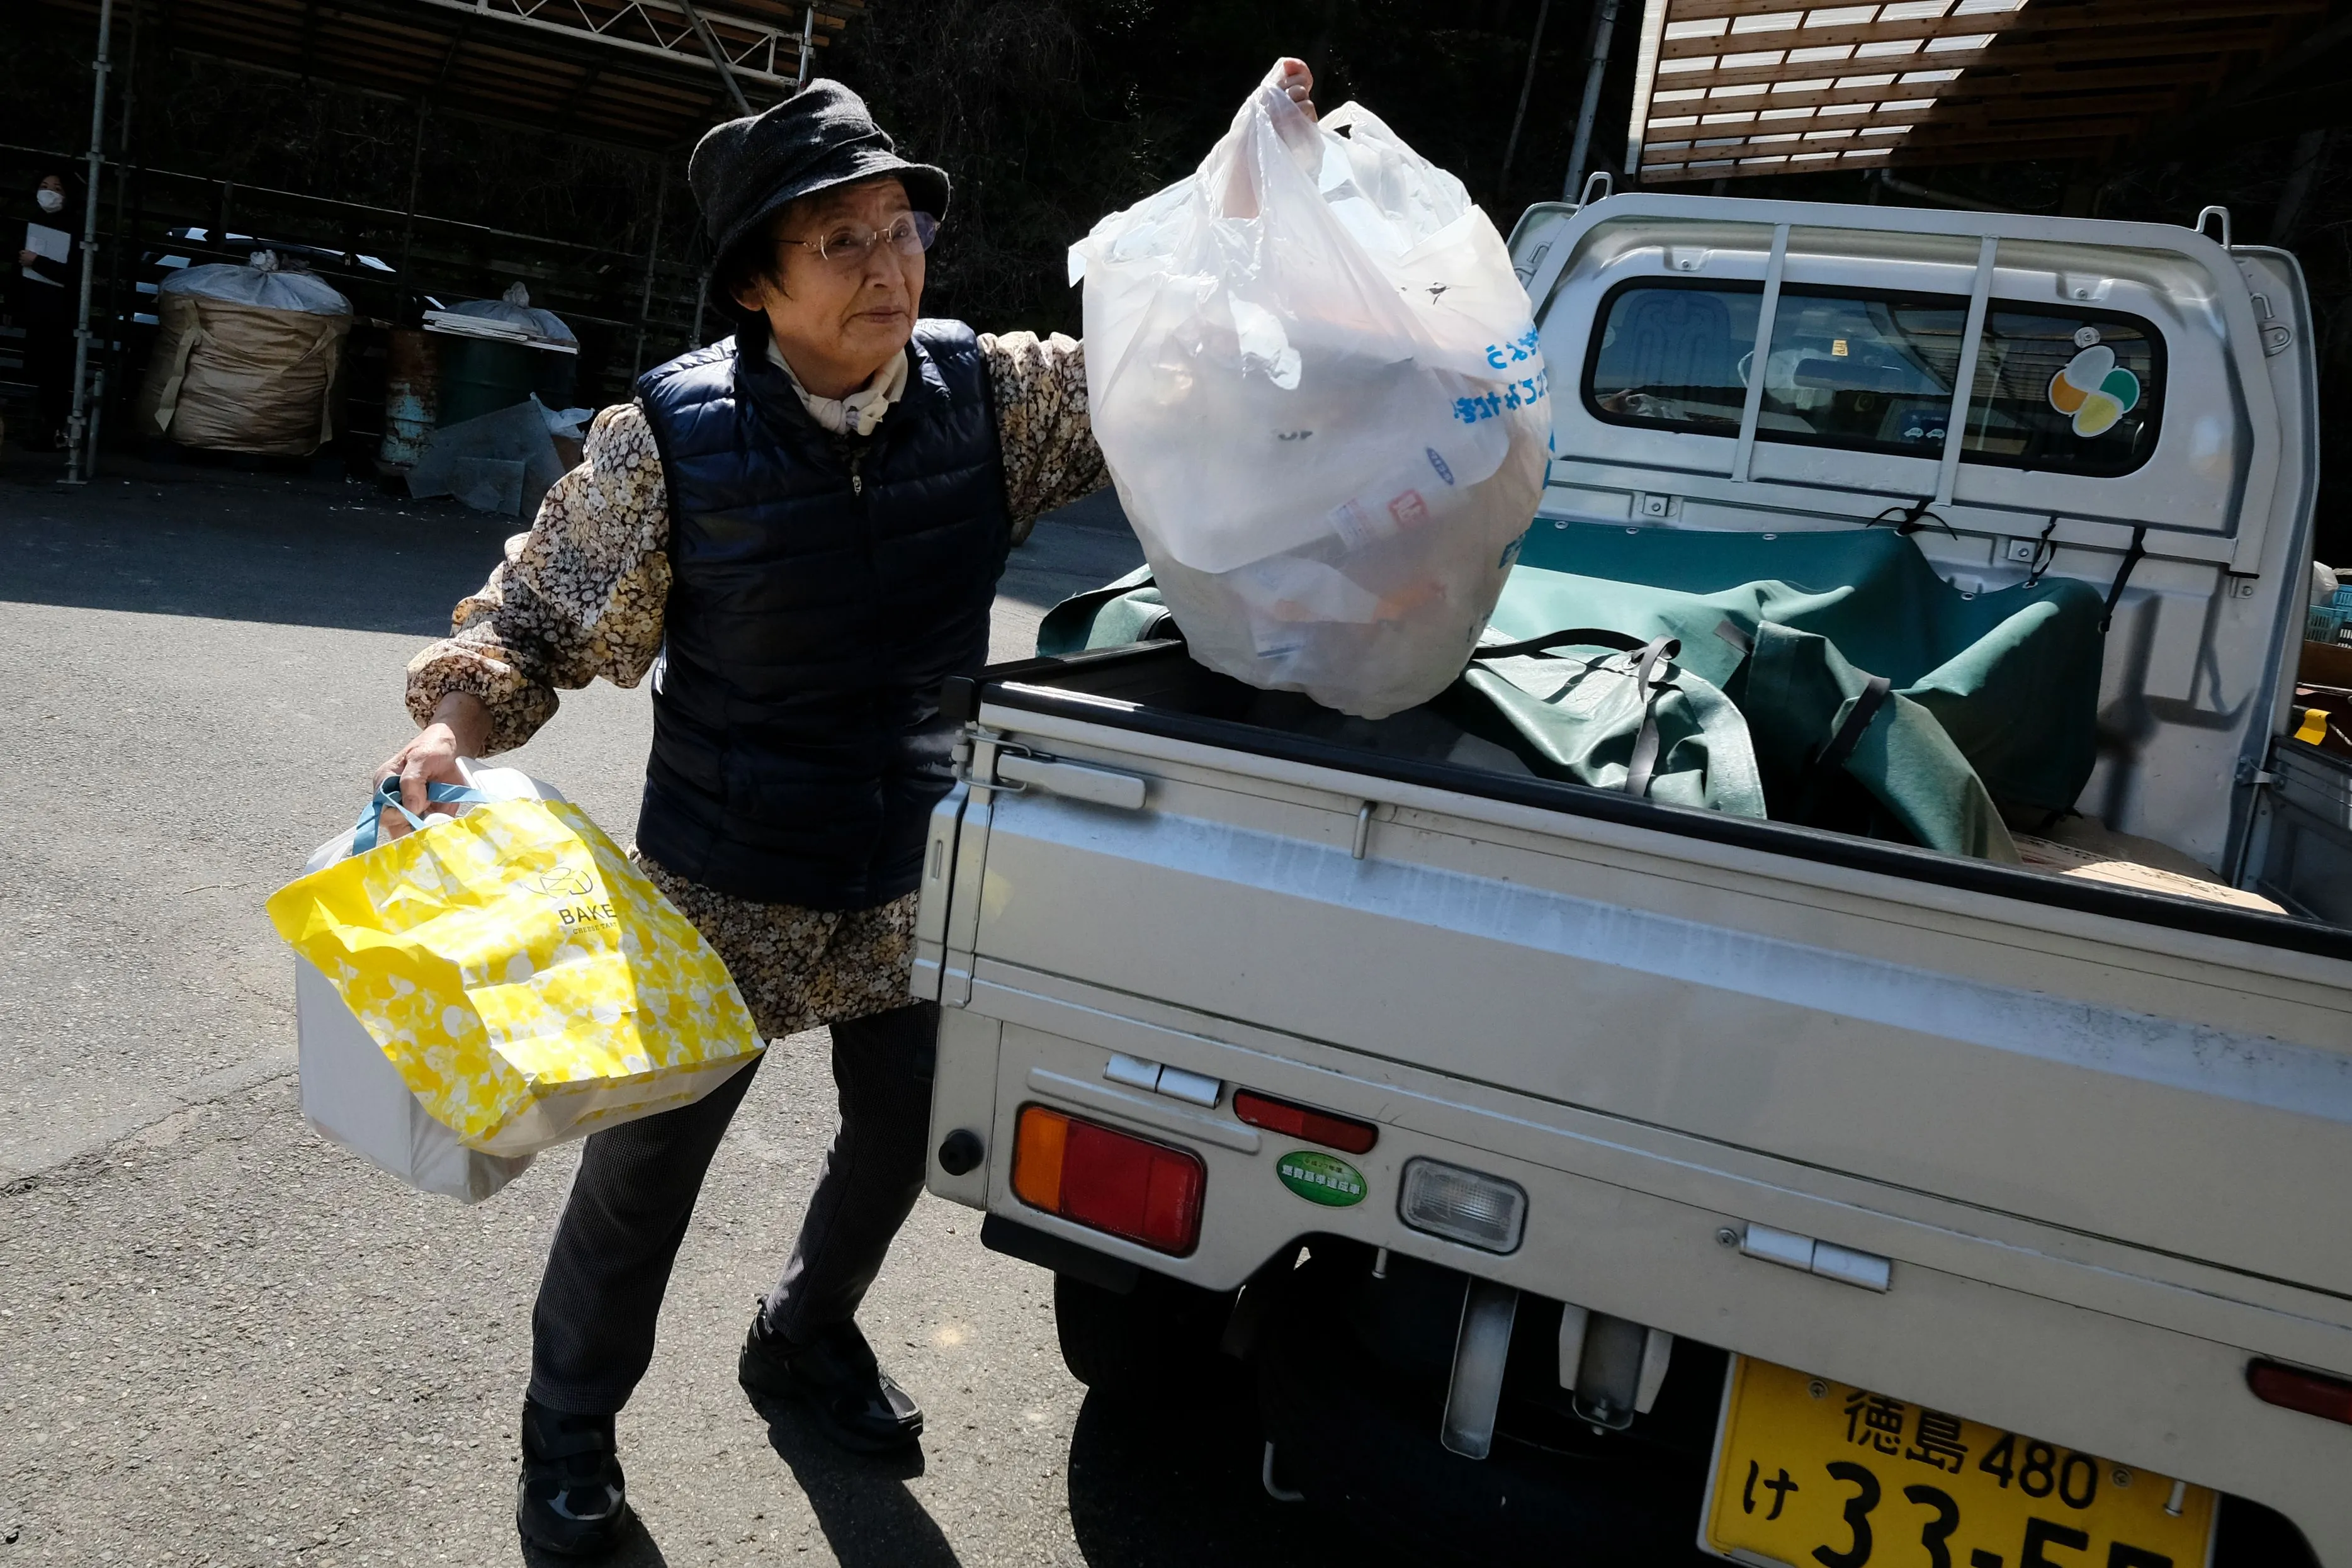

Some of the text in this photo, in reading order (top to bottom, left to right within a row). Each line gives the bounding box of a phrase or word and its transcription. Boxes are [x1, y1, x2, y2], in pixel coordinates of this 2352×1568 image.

[558, 904, 617, 925] BAKE
[573, 925, 599, 935] CHEESE
[1743, 1460, 1799, 1521] け
